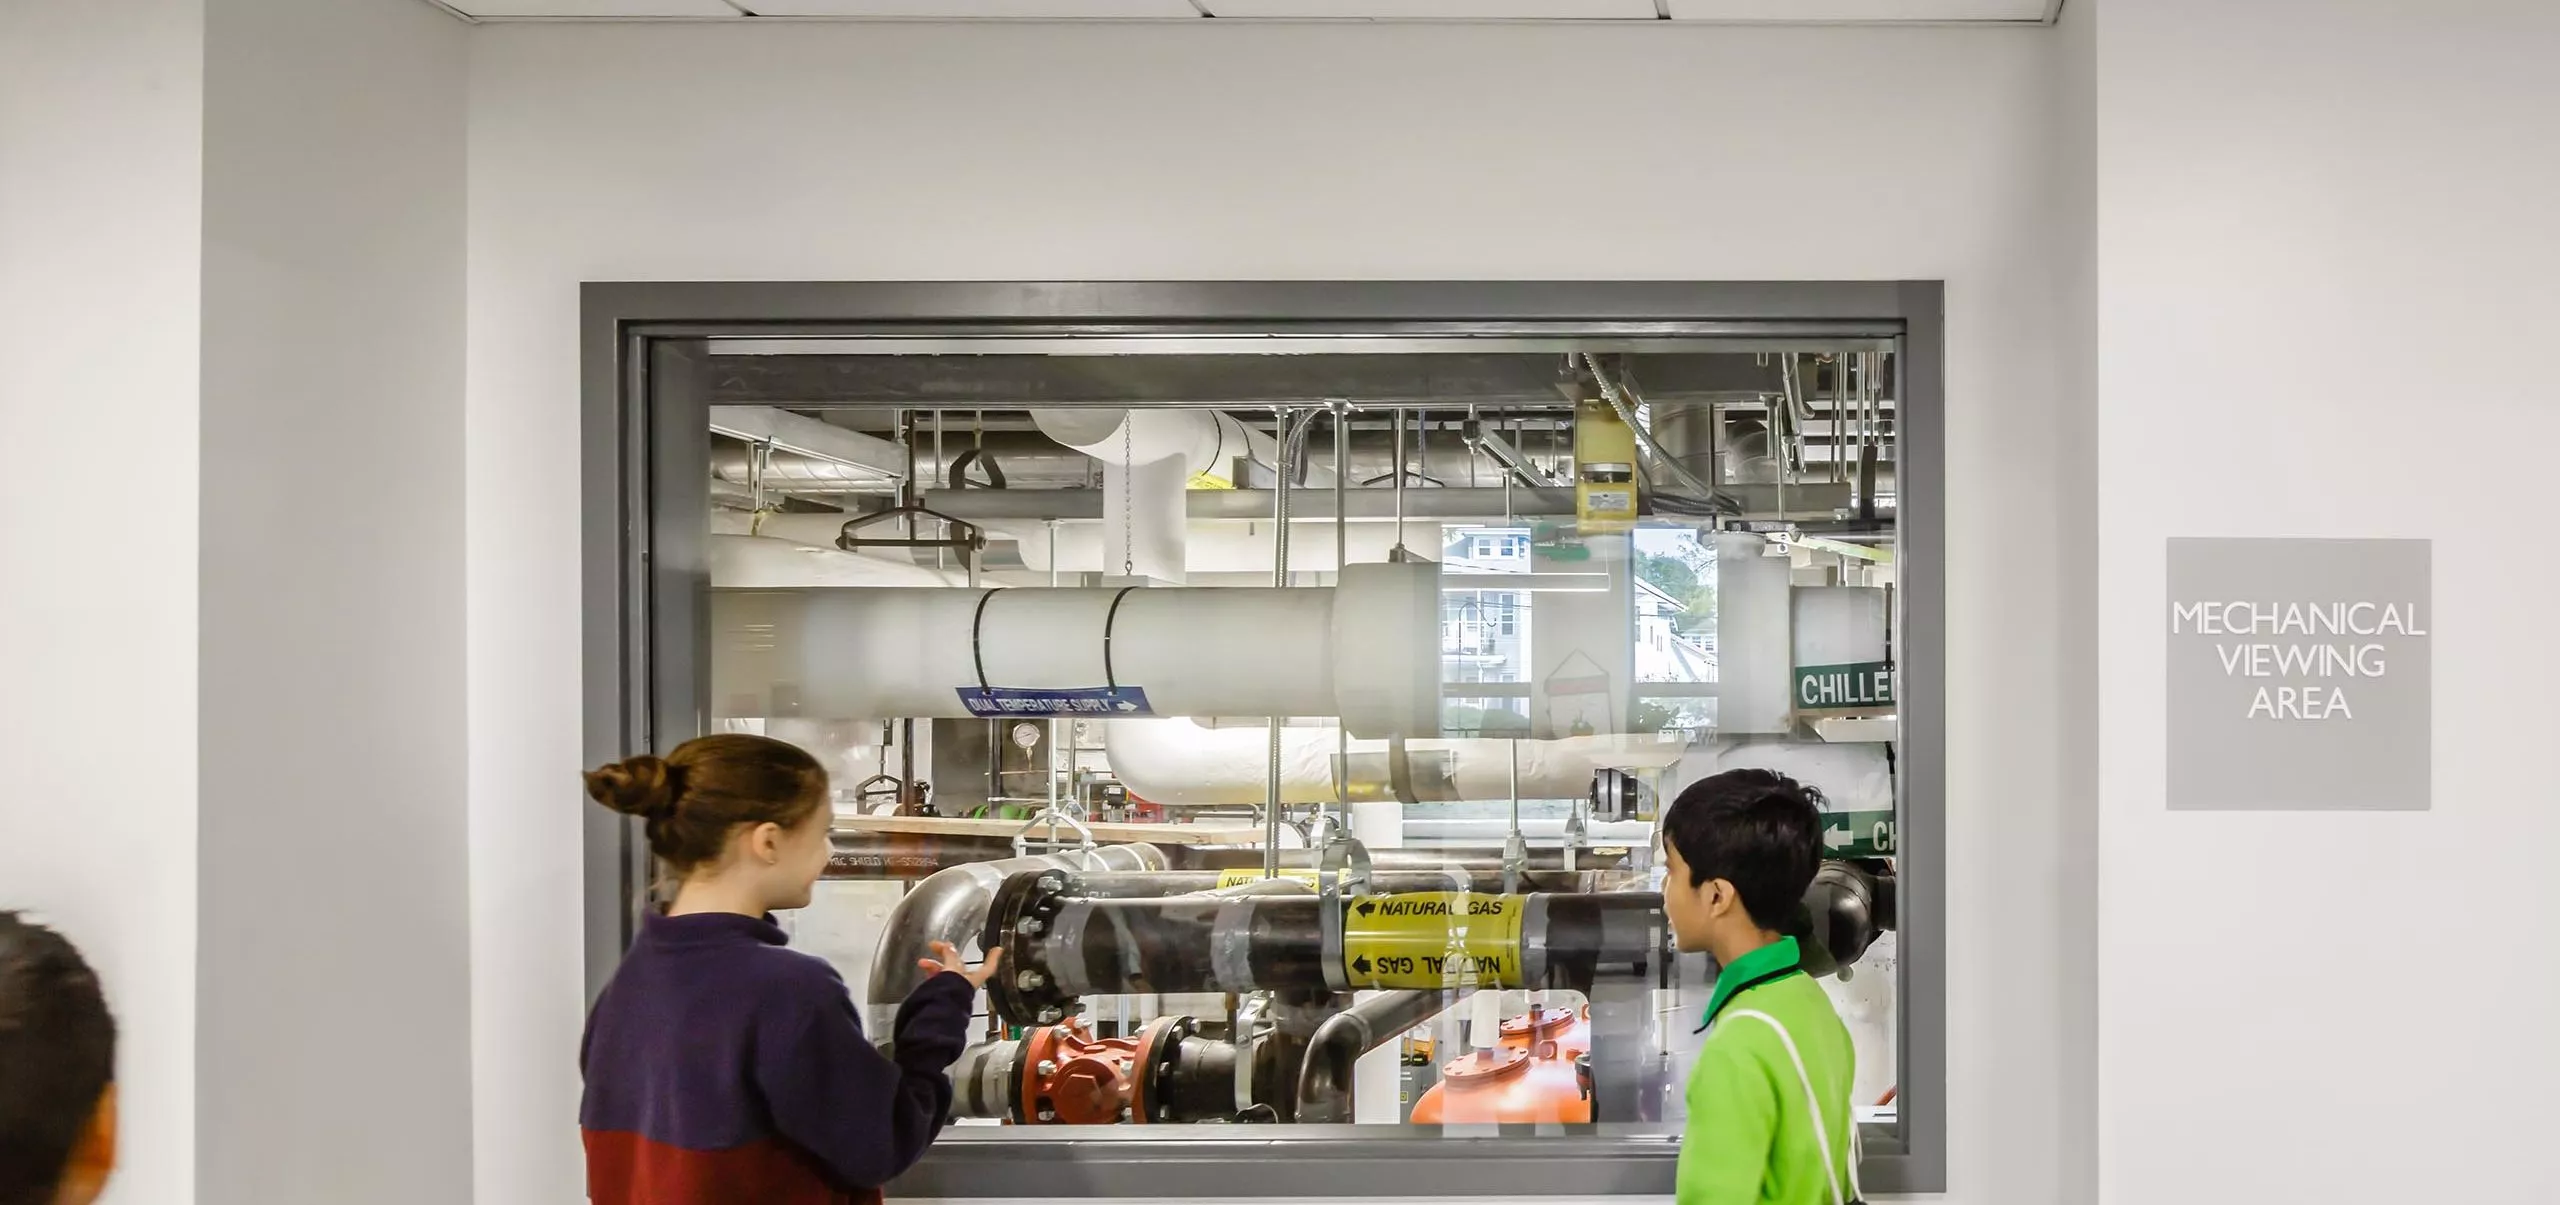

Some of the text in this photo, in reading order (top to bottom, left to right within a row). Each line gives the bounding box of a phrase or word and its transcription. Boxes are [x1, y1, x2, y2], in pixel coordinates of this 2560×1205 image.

[2173, 601, 2427, 635] MECHANICAL
[2216, 644, 2385, 677] VIEWING
[968, 698, 1113, 712] DUAL TEMPERATURE SUPPLY
[2247, 686, 2352, 719] AREA
[1467, 901, 1503, 915] GAS
[1376, 956, 1413, 974] GAS
